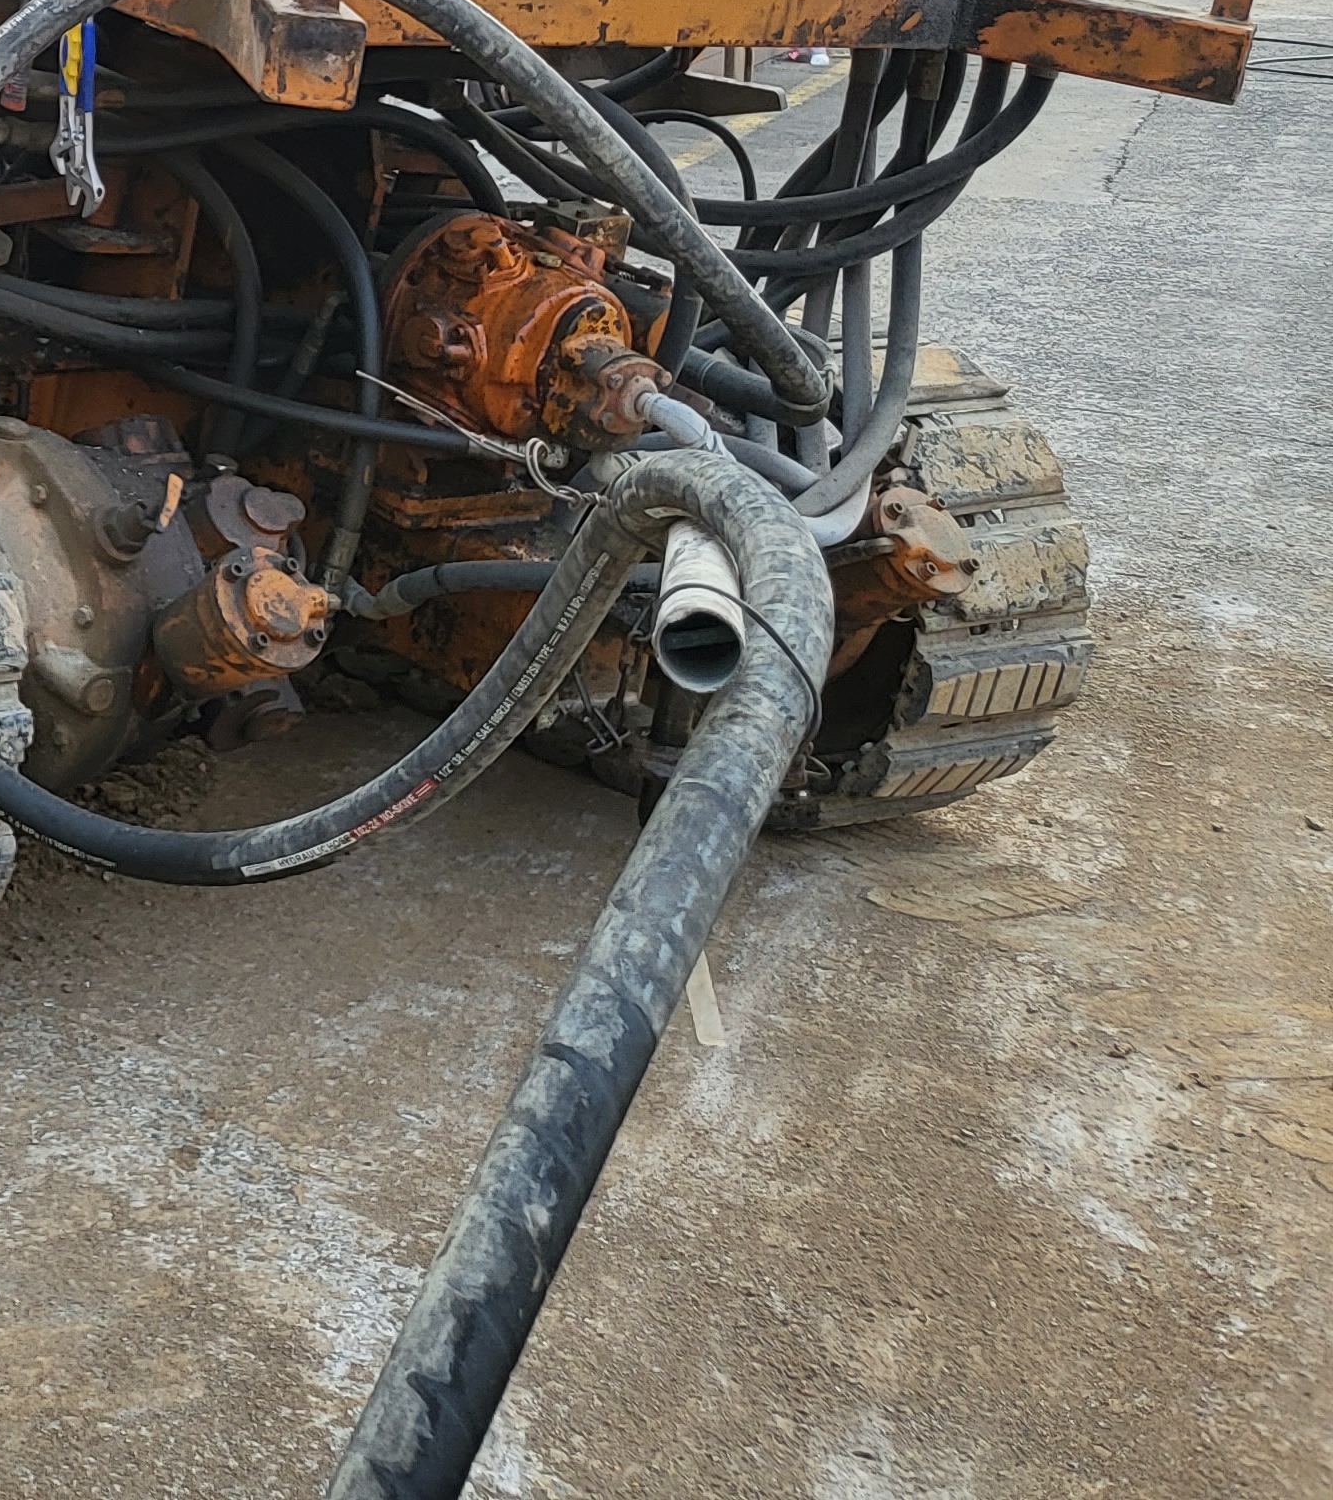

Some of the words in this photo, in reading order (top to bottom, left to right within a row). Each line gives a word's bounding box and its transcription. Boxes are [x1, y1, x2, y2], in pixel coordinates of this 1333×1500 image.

[277, 844, 329, 868] HYDRAULIC
[328, 833, 351, 853] HOSE
[380, 793, 419, 824] NO-SKIVE
[475, 722, 493, 741] SAE
[535, 644, 554, 665] TYPE
